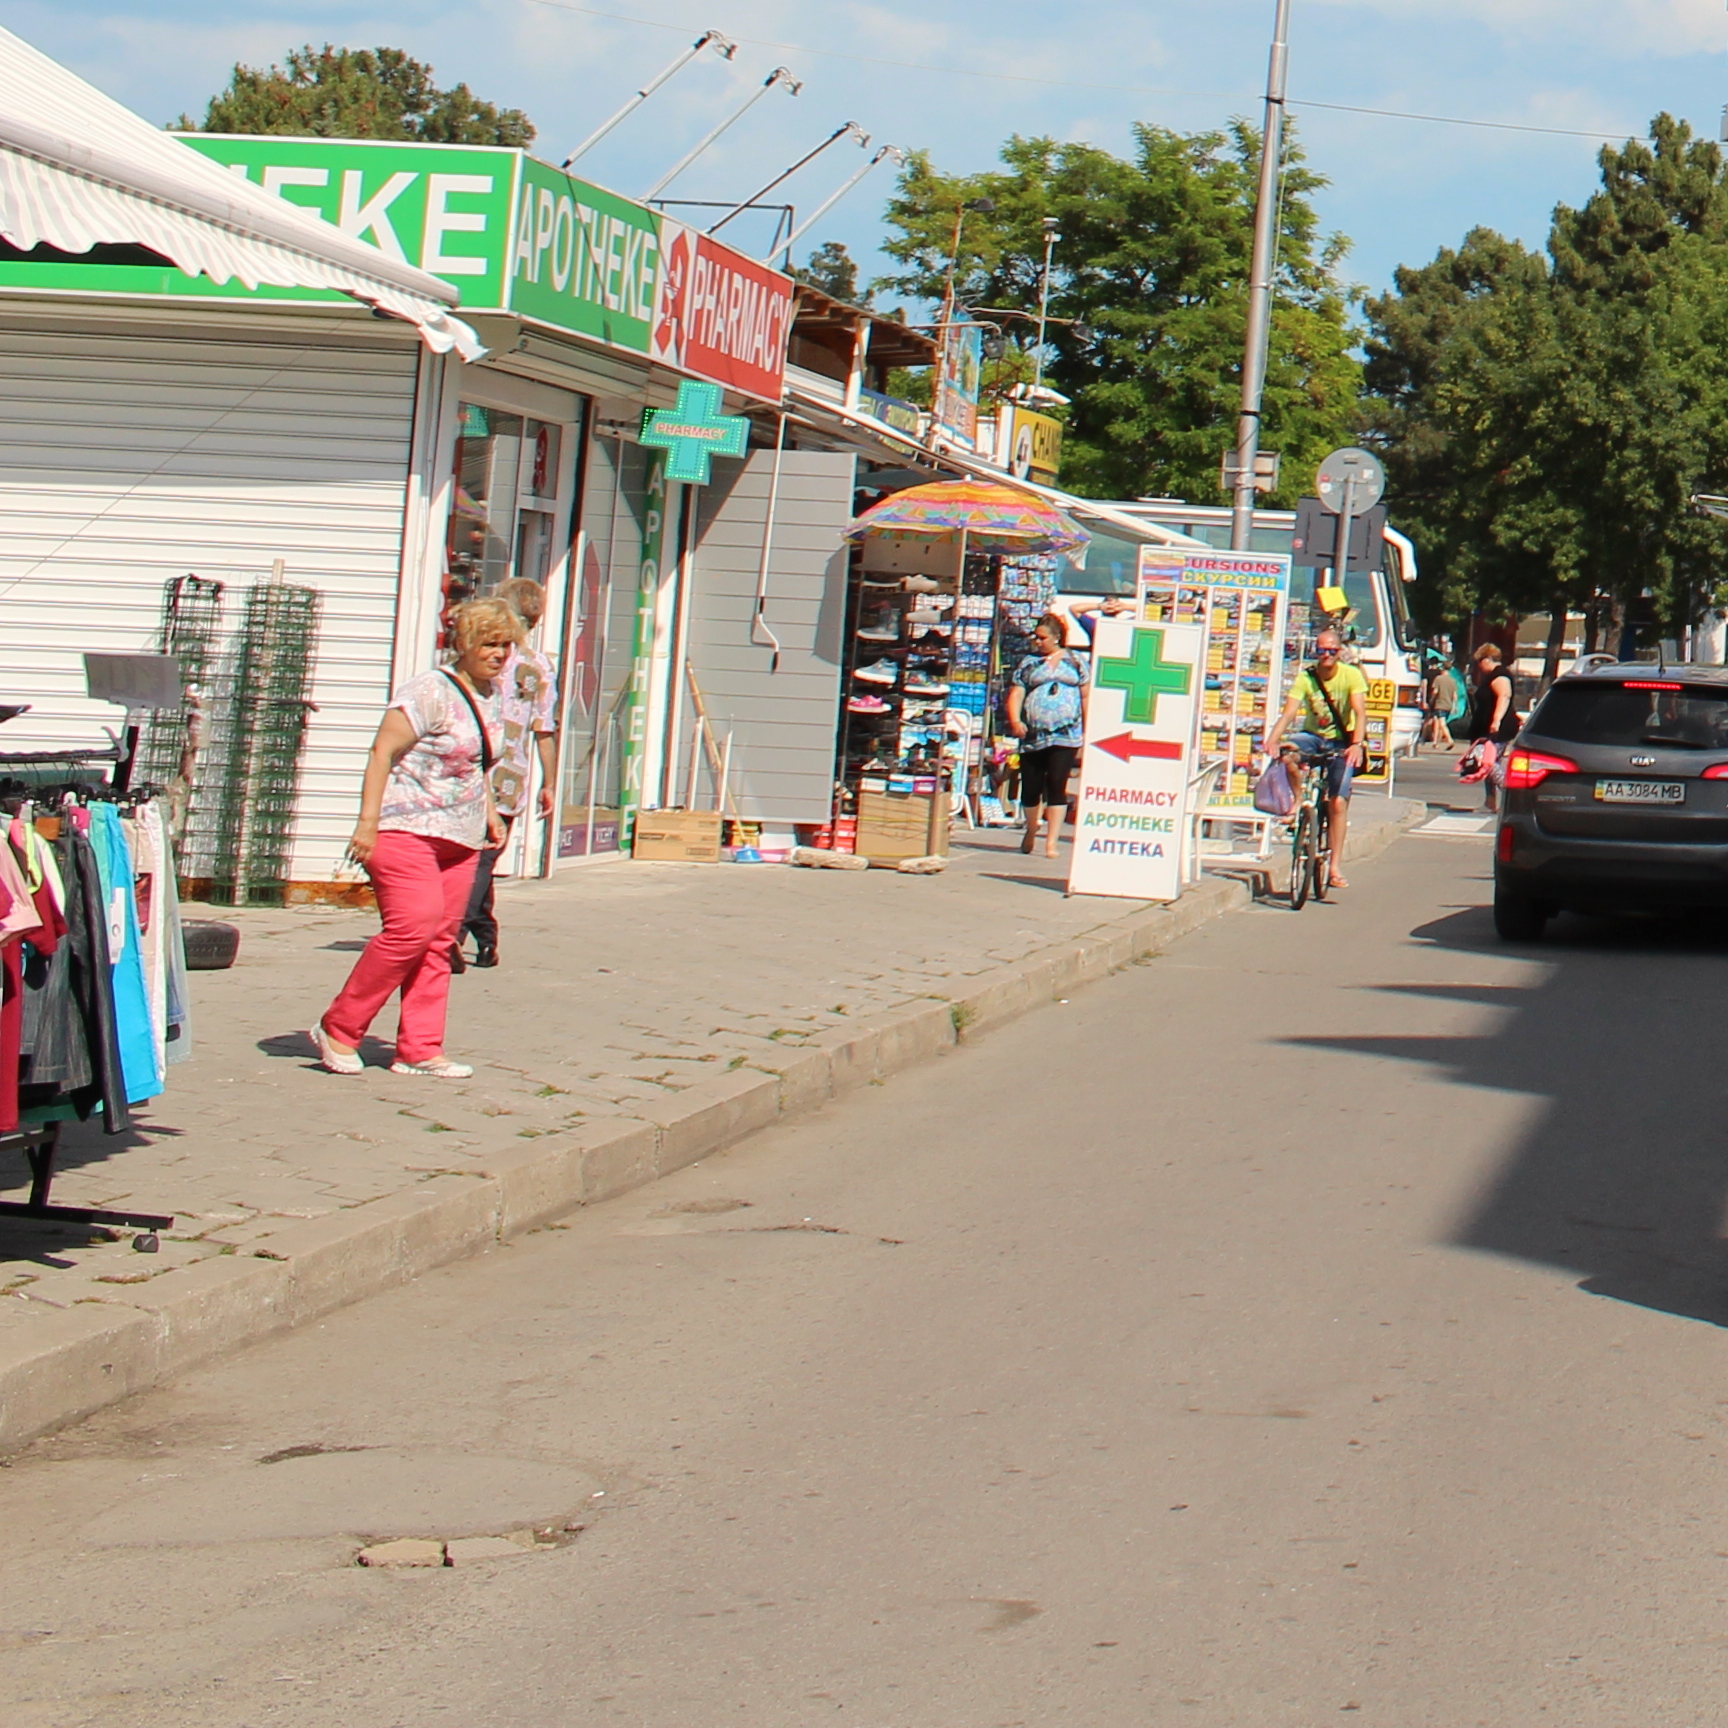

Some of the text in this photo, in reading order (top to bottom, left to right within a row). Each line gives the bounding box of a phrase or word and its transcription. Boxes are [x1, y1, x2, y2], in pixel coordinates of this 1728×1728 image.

[512, 182, 659, 323] APOTHEKE
[688, 254, 793, 377] PHARMACY
[655, 421, 728, 440] PHARMACY
[620, 461, 665, 841] APOTHEKE
[1631, 756, 1652, 766] KIA
[1084, 786, 1178, 807] PHARMACY
[1604, 783, 1682, 799] AA 3084 MB
[1083, 811, 1175, 833] APOTHEKE
[1088, 839, 1164, 858] АПТЕКА
